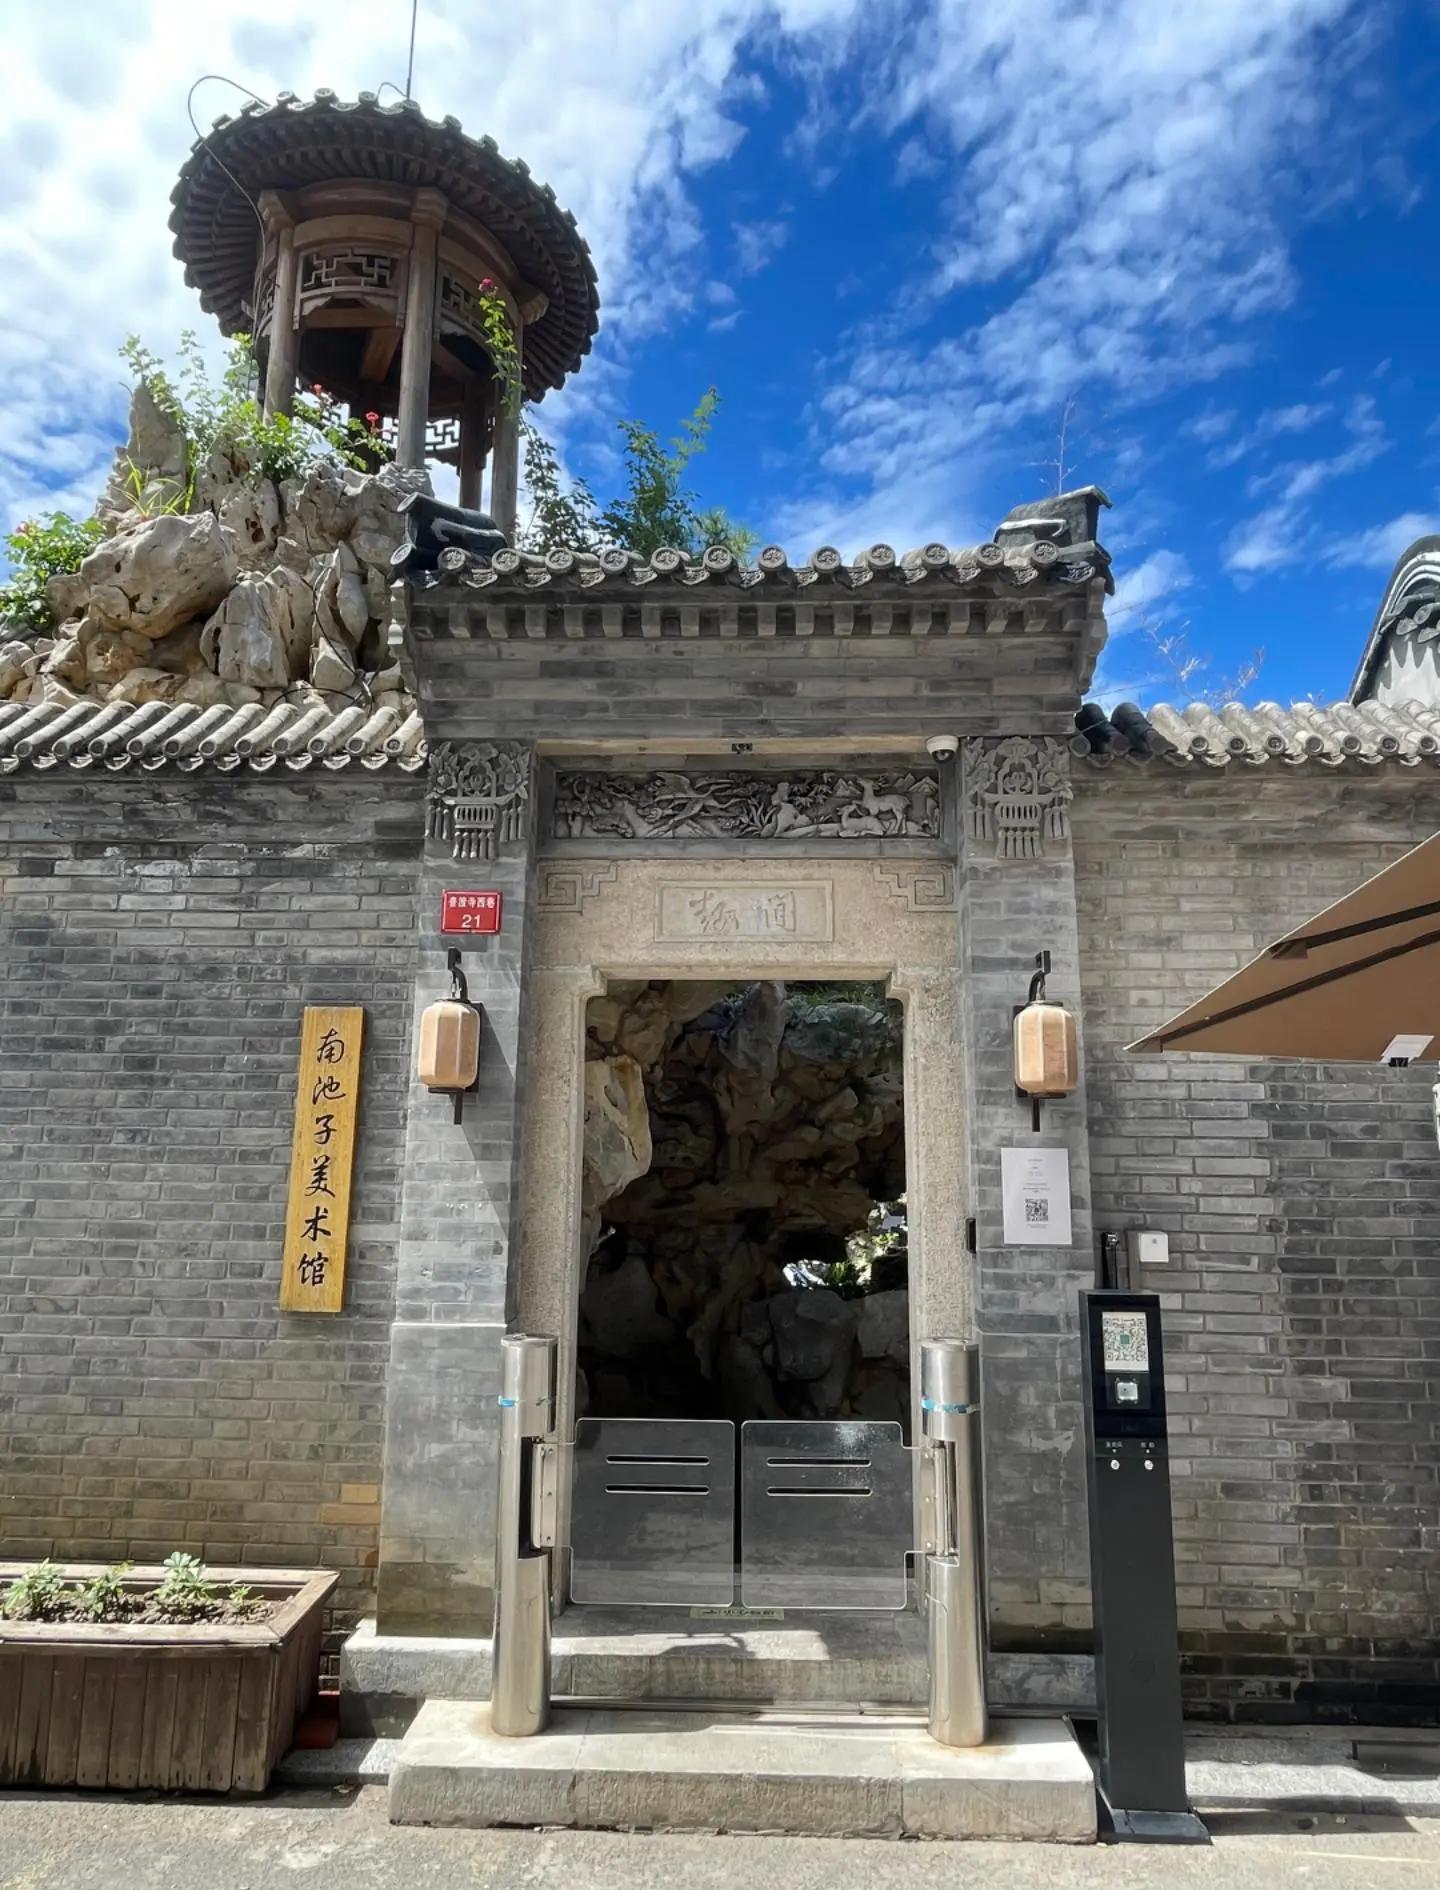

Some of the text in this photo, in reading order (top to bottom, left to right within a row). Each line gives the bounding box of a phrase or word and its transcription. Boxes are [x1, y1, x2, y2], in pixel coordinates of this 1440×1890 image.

[461, 914, 481, 928] 21
[297, 1028, 346, 1286] 南池子美术馆
